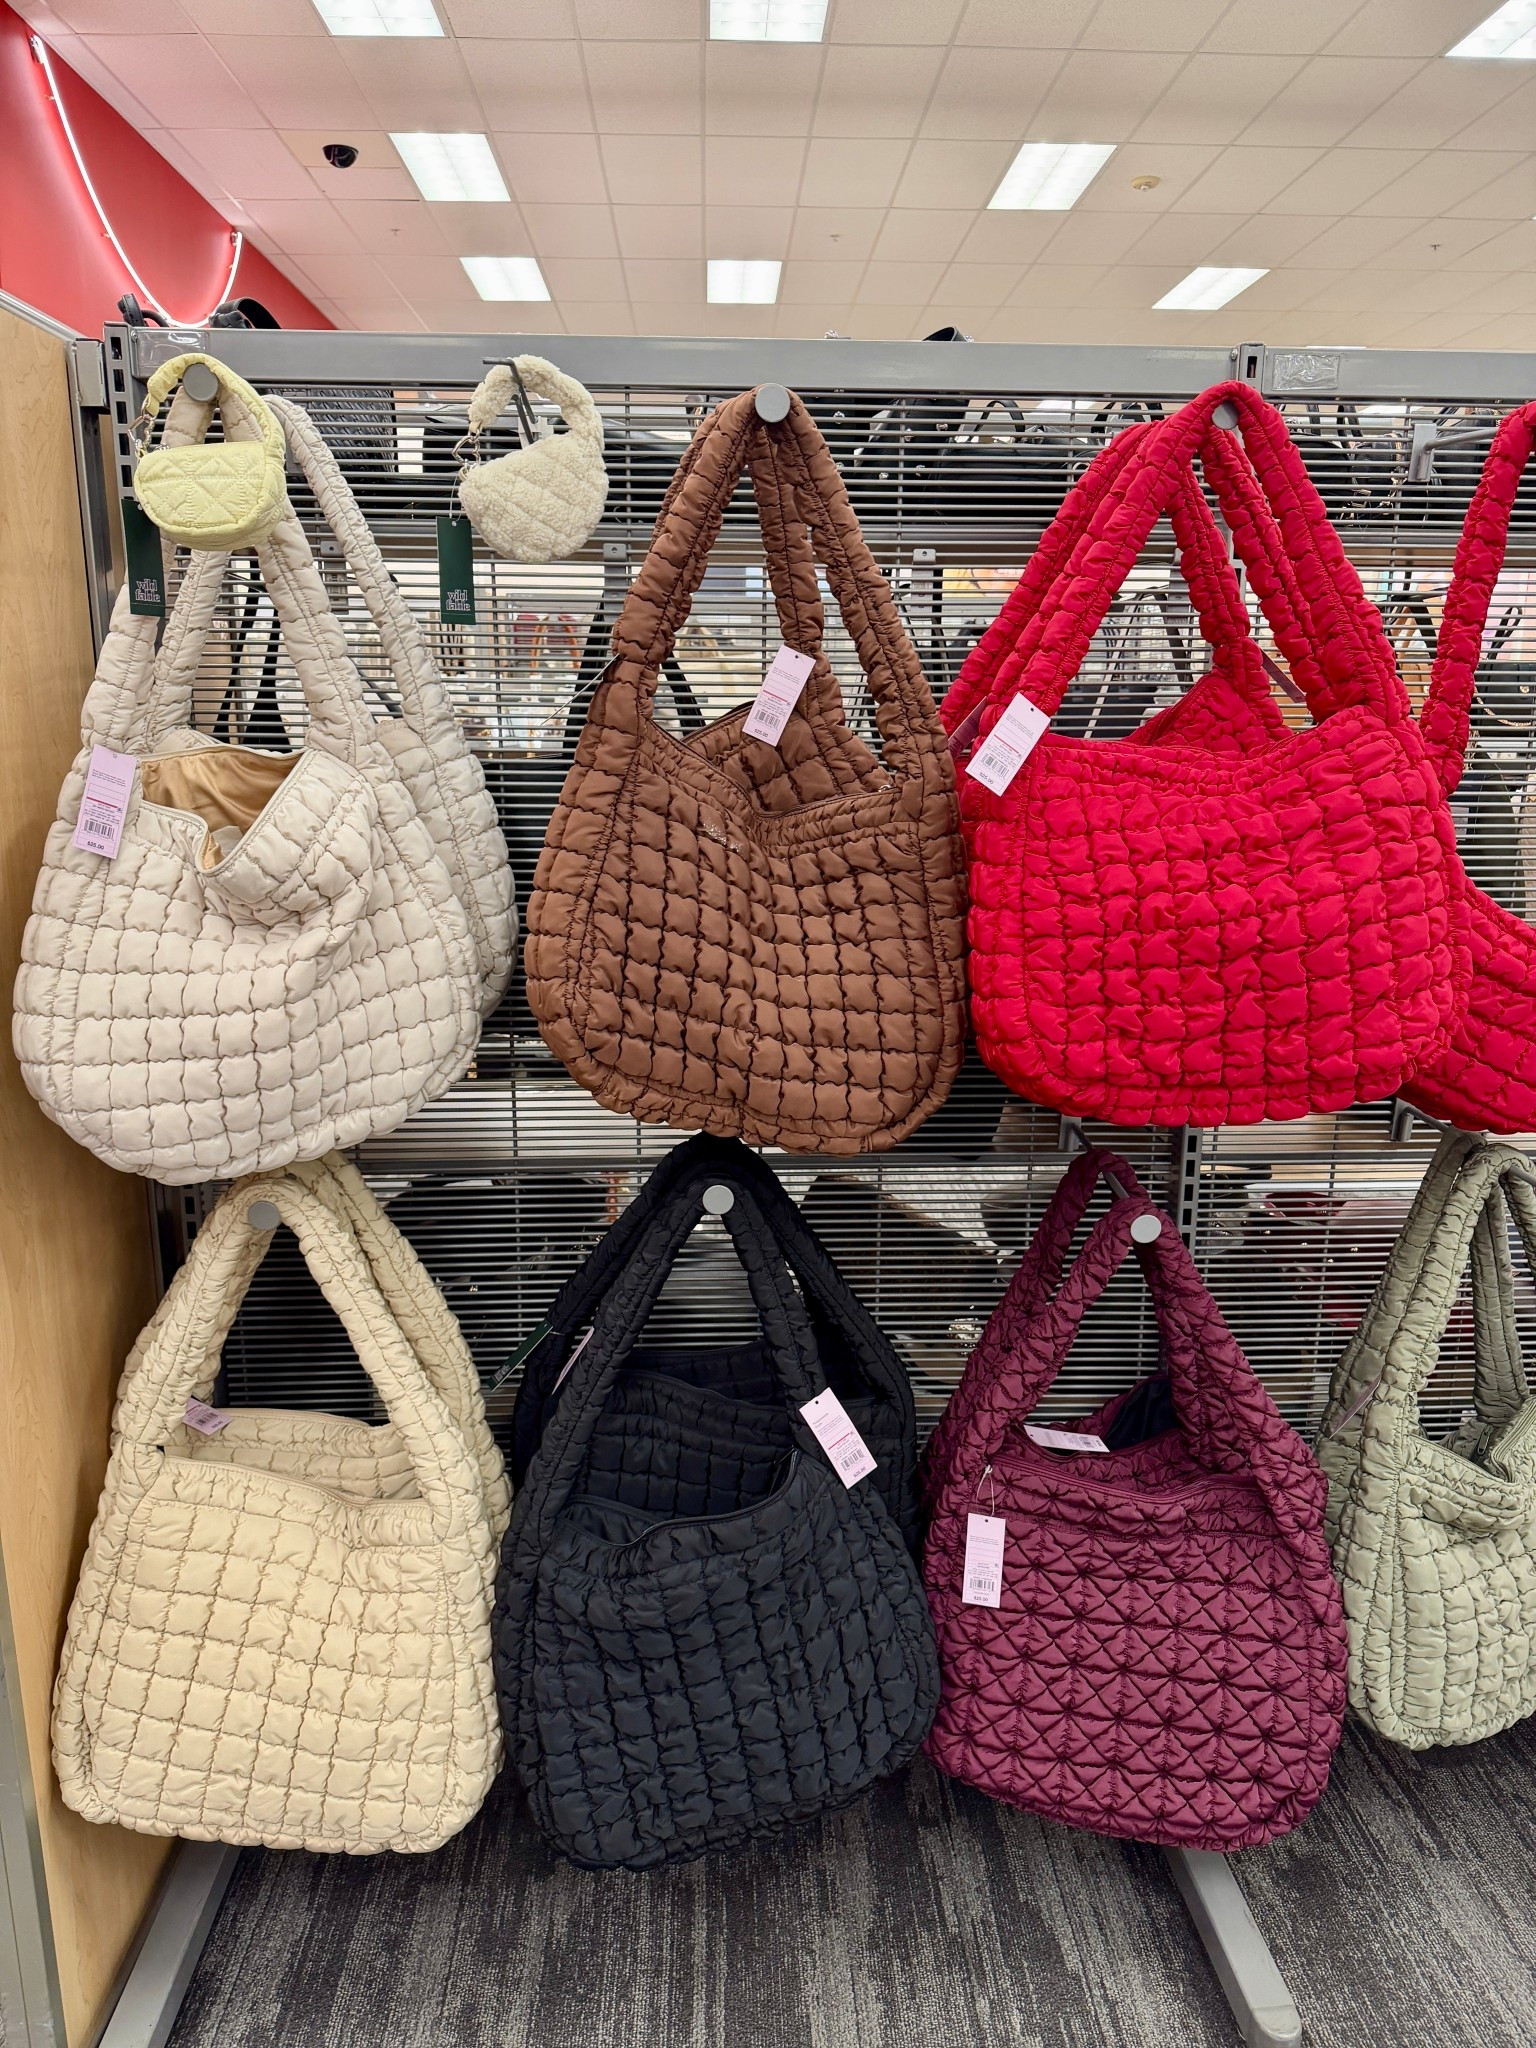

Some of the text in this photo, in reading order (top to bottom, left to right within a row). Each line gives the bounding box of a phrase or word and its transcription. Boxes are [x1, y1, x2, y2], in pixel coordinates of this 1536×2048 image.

[136, 578, 158, 592] wild
[135, 588, 161, 602] fable
[447, 589, 468, 601] wild
[87, 840, 105, 850] $25.00
